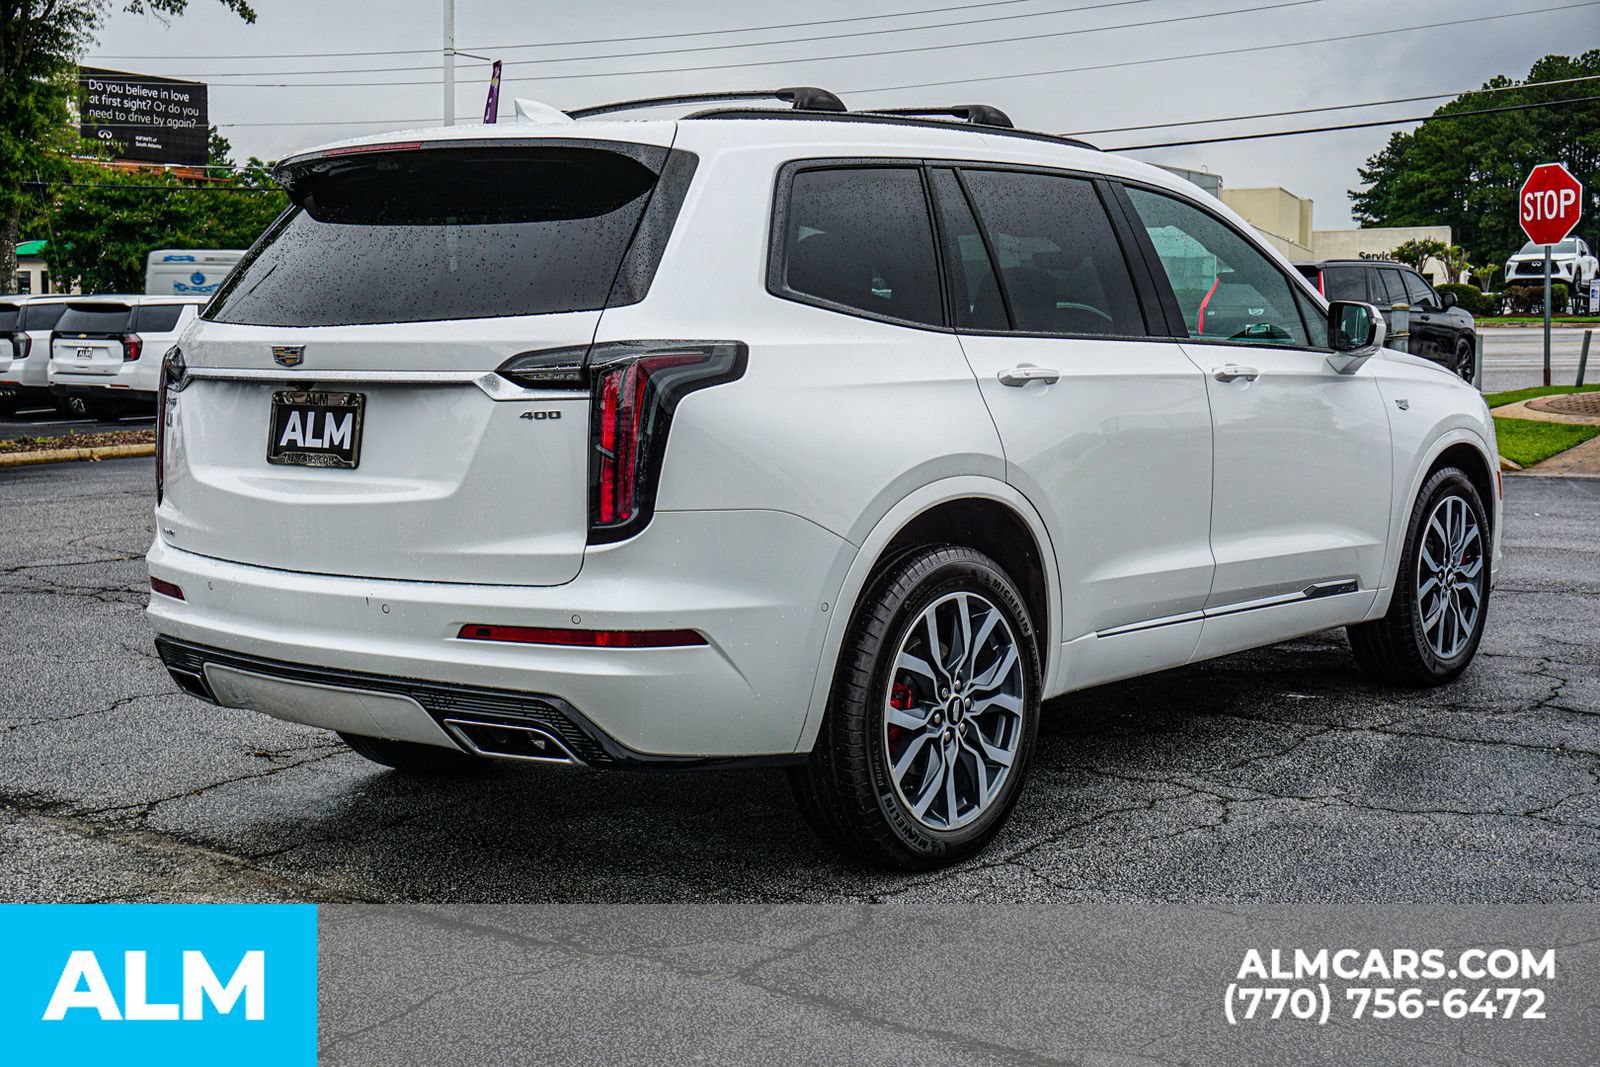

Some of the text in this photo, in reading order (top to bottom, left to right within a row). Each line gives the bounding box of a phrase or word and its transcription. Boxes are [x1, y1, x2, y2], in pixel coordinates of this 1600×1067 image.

[89, 79, 189, 102] Do you believe in love
[89, 94, 199, 116] at first sight? Or do you
[90, 109, 196, 129] need to drive by again?
[1523, 188, 1576, 222] STOP
[306, 393, 329, 405] ALM
[519, 409, 562, 420] 400
[279, 410, 354, 450] ALM
[991, 578, 1030, 634] MICHELIN
[884, 794, 929, 850] MICHELIN
